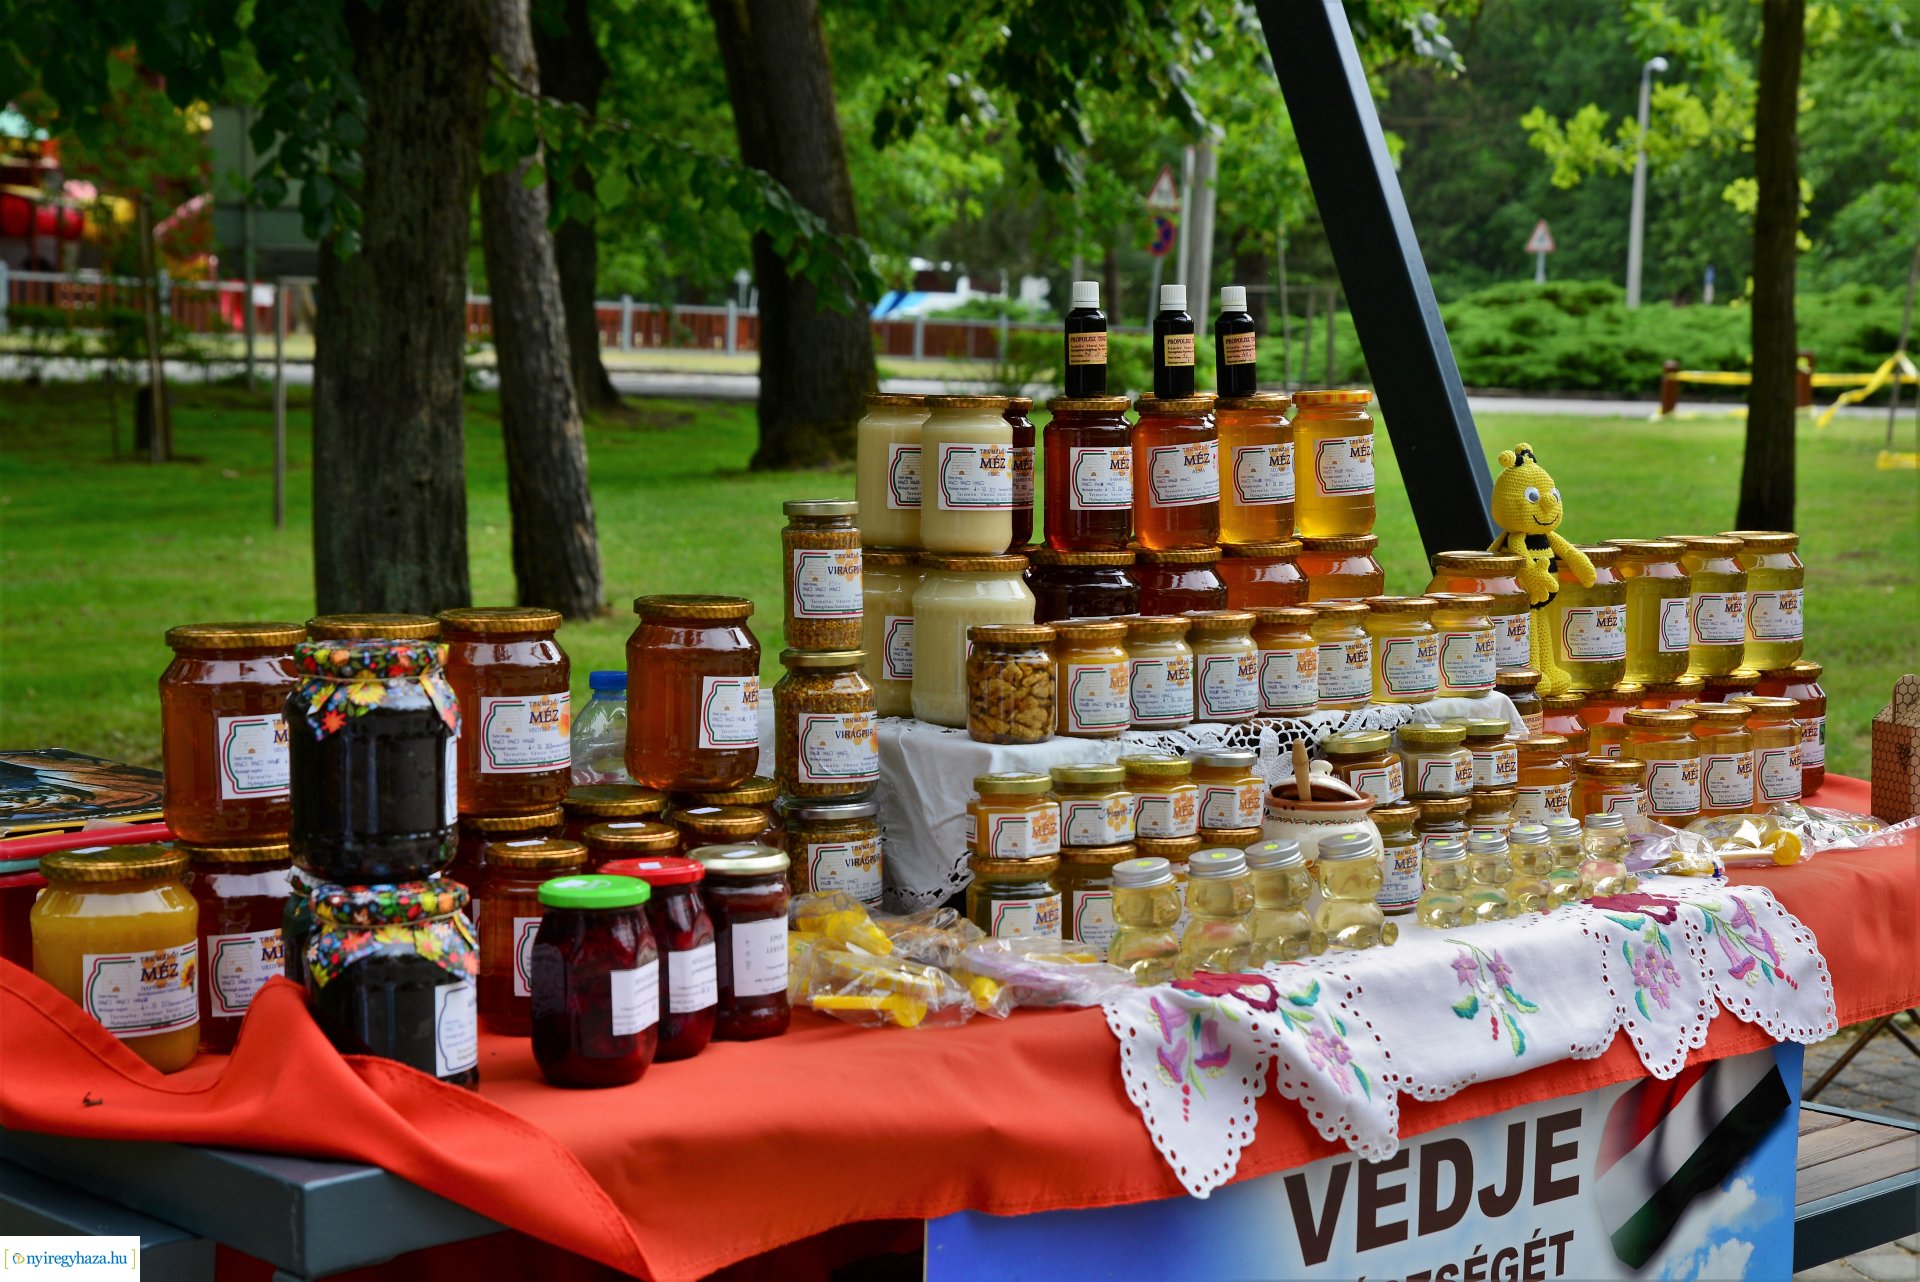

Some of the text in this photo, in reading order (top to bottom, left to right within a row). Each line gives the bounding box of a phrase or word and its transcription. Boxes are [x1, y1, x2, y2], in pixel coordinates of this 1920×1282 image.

[1350, 445, 1371, 457] MÉZ
[979, 455, 1006, 469] MÉZ
[1109, 456, 1130, 469] MÉZ
[1184, 453, 1210, 466] MÉZ
[1269, 453, 1291, 466] MÉZ
[1725, 601, 1743, 613] MÉZ
[1779, 598, 1798, 610] MÉZ
[1596, 615, 1618, 628] MÉZ
[1507, 623, 1526, 636] MÉZ
[1418, 644, 1438, 658] MÉZ
[1475, 640, 1494, 653] MÉZ
[1346, 649, 1369, 664] MÉZ
[1296, 659, 1317, 672] MÉZ
[1166, 668, 1190, 681] MÉZ
[528, 707, 559, 724] MÉZ
[1496, 760, 1517, 773] MÉZ
[1737, 760, 1753, 774] MÉZ
[1455, 766, 1473, 781] MÉZ
[1682, 768, 1699, 781] MÉZ
[1239, 795, 1260, 810] MÉZ
[1544, 794, 1568, 809] MÉZ
[1173, 803, 1195, 818] MÉZ
[1032, 820, 1058, 838] MÉZ
[1394, 855, 1418, 870] MÉZ
[1036, 908, 1060, 925] MÉZ
[140, 961, 179, 982] MÉZ
